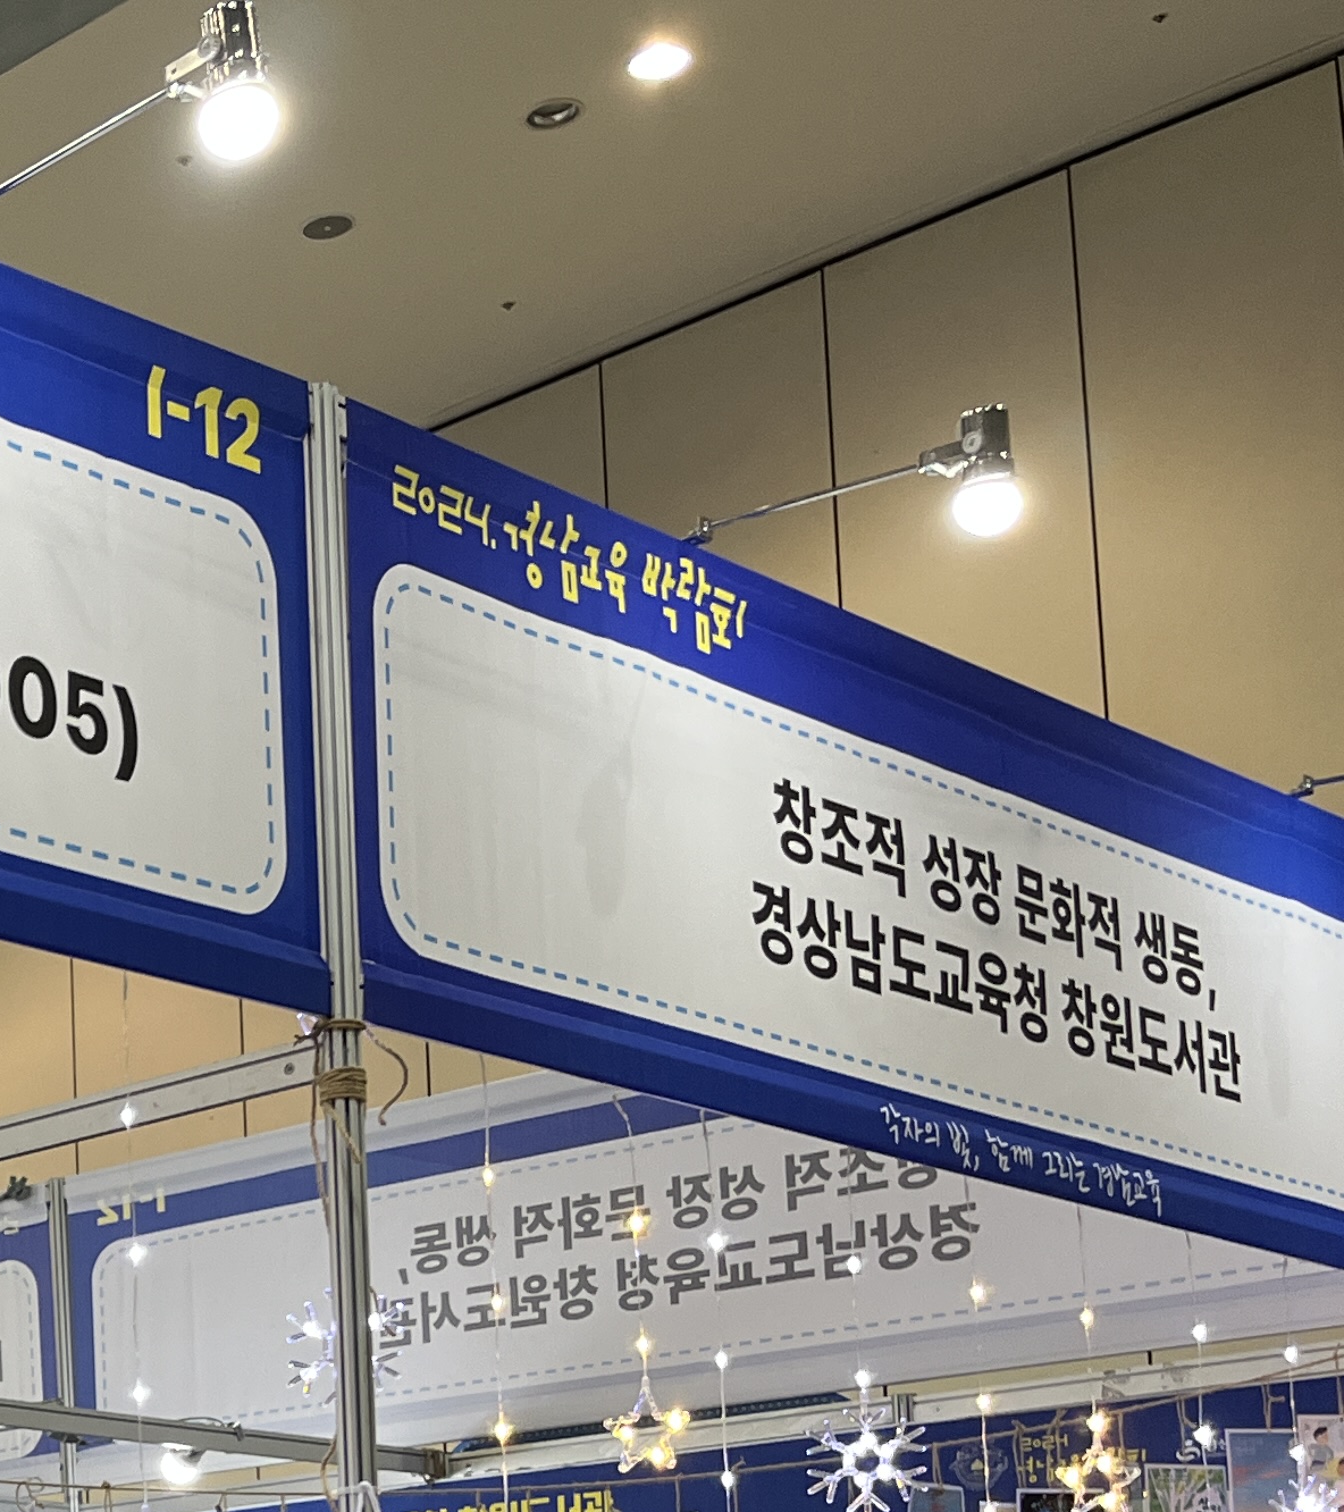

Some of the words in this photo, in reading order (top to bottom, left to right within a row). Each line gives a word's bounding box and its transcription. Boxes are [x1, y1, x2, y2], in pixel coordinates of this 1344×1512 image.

[147, 365, 261, 474] I-12
[503, 500, 628, 613] 경남교육
[641, 553, 747, 654] 박람회
[773, 778, 907, 898] 창조적
[923, 835, 1001, 925] 성장
[1014, 864, 1122, 971] 문화적
[1135, 910, 1216, 1011] 생동,
[752, 882, 1049, 1042] 경상남도교육청
[1062, 978, 1242, 1103] 창원도서관
[881, 1104, 940, 1148] 각자의
[947, 1125, 980, 1171] 빛,
[985, 1130, 1033, 1171] 함께
[1042, 1151, 1090, 1192] 그리는
[1093, 1163, 1163, 1217] 경남교육
